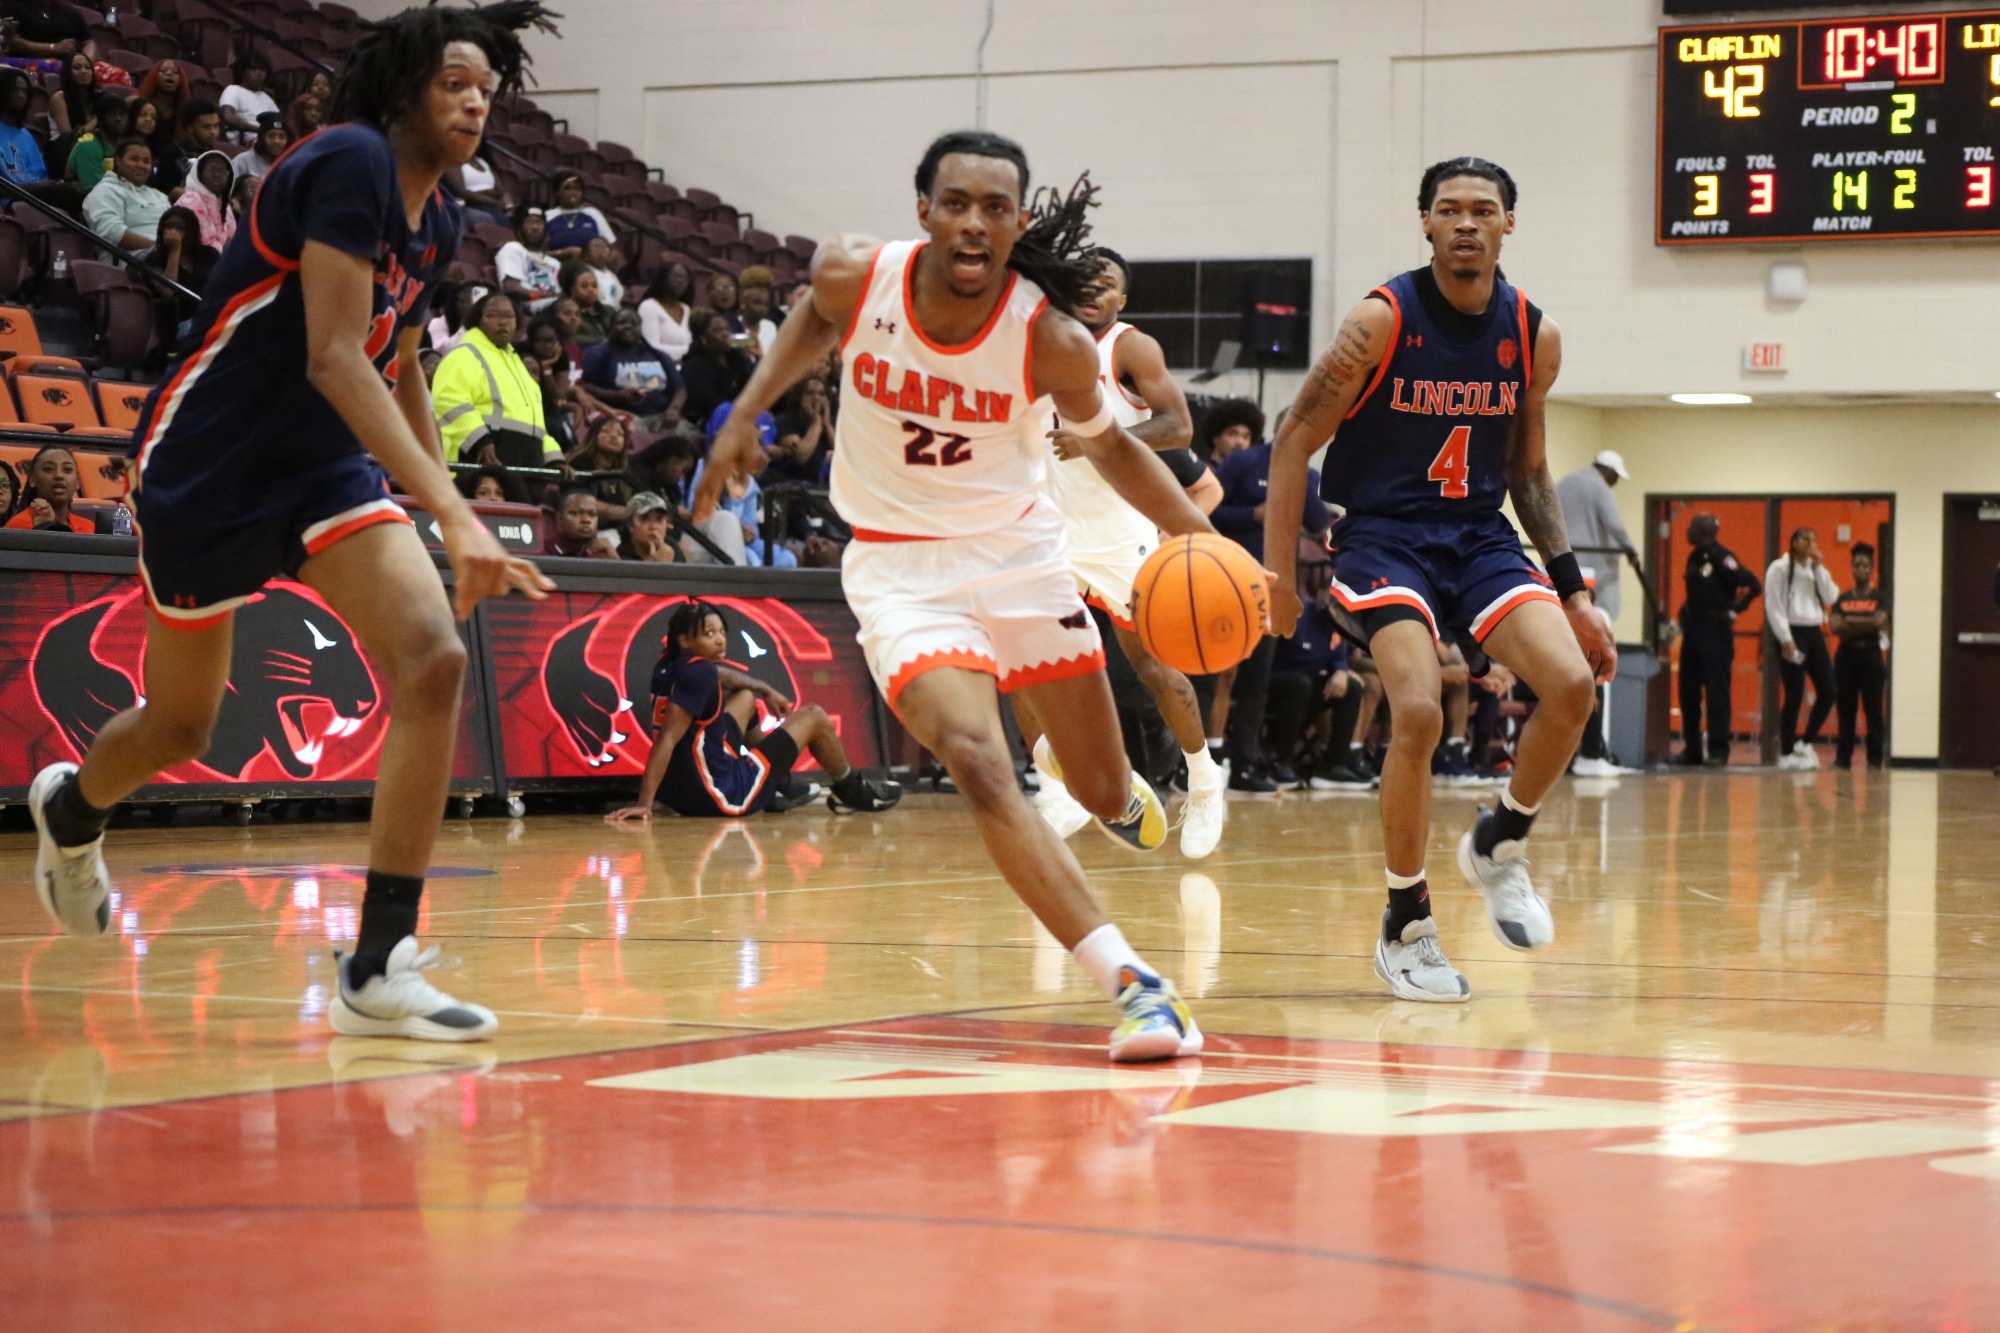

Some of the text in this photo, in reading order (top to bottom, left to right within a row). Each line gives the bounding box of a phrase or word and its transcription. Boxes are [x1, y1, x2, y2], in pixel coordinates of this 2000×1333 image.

[1678, 34, 1781, 62] CLAFLIN
[1824, 23, 1938, 80] 10:40
[1703, 64, 1765, 118] 42
[1801, 93, 1916, 134] PERIOD 2
[1675, 155, 1727, 172] FOULS
[1745, 154, 1776, 170] TOL
[1811, 149, 1926, 168] PLAYER-FOUL
[1962, 146, 1995, 162] TOL
[1693, 174, 1718, 216] 3
[1748, 173, 1773, 214] 3
[1833, 171, 1868, 211] 14
[1893, 169, 1917, 209] 2
[1965, 166, 1991, 207] 3
[1671, 220, 1729, 236] POINTS
[1812, 215, 1873, 232] MATCH
[1752, 343, 1782, 368] EXIT
[852, 351, 1014, 424] CLAFLIN
[1390, 378, 1519, 416] LINCOLN
[901, 419, 973, 467] 22
[1427, 425, 1472, 499] 4
[498, 525, 520, 540] BONUS
